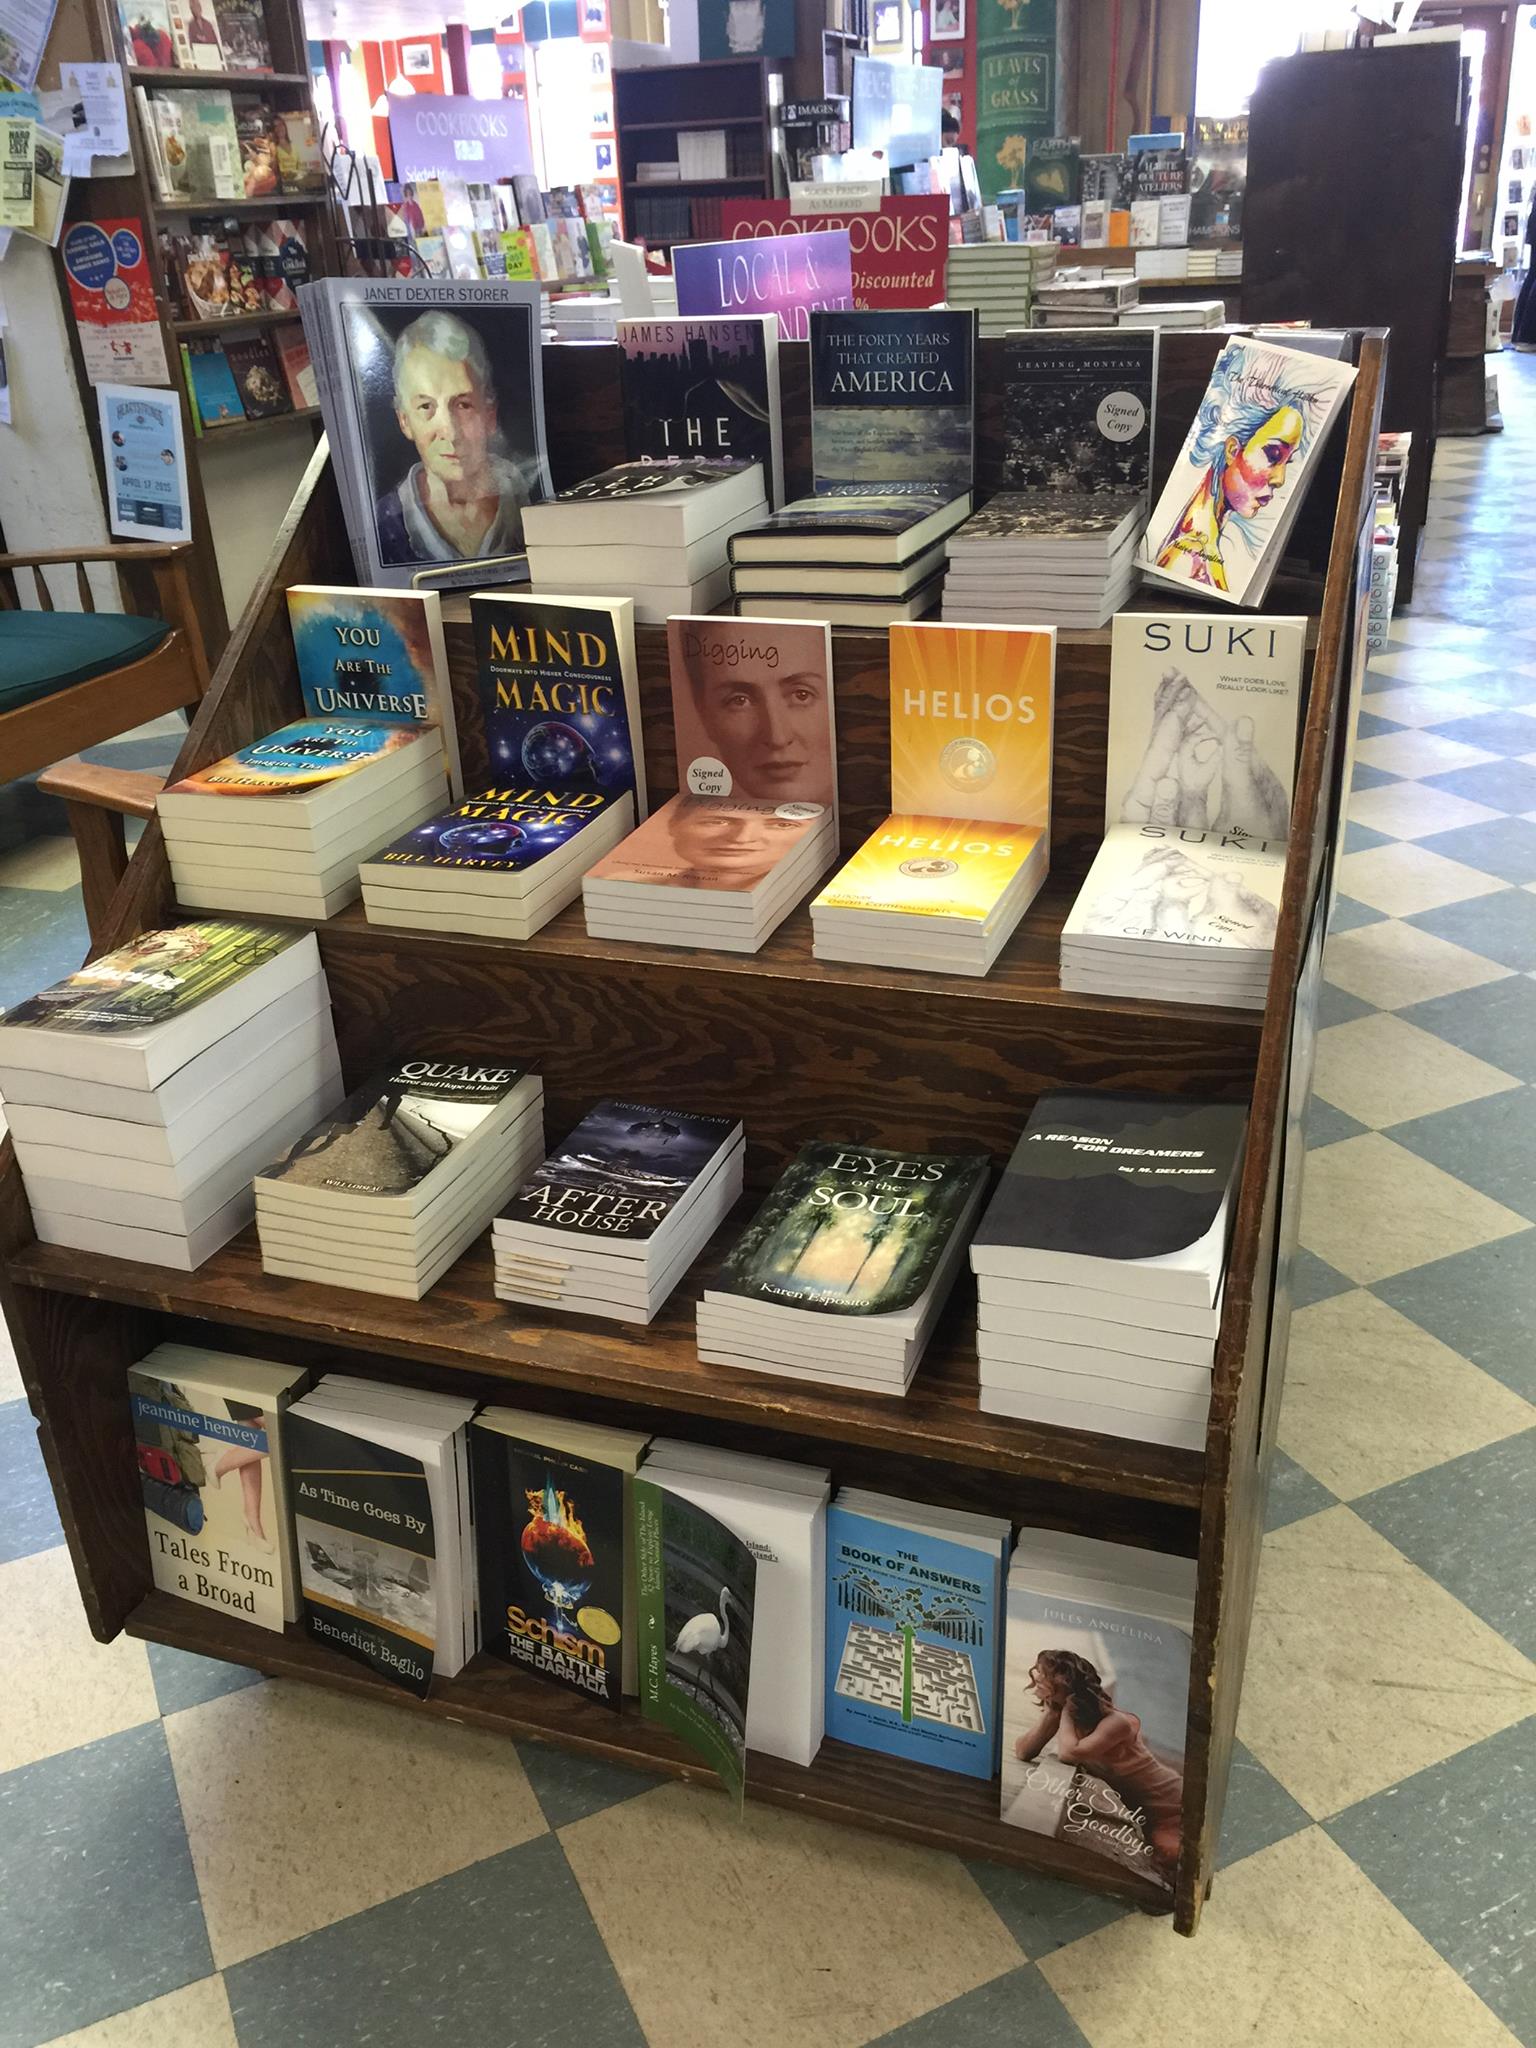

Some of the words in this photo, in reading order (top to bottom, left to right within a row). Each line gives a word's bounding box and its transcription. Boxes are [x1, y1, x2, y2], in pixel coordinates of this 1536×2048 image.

[988, 58, 1041, 78] LEAVES
[991, 89, 1038, 108] GRASS
[798, 105, 833, 115] IMAGES
[416, 111, 508, 138] COOKBOOKS
[1033, 139, 1072, 151] EARTH
[1138, 170, 1184, 182] COUTURE
[717, 252, 796, 307] LOCAL
[805, 246, 821, 291] &
[851, 270, 935, 289] Discounted
[364, 287, 402, 300] JANET
[405, 287, 455, 300] DEXTER
[458, 287, 509, 300] STORER
[623, 326, 674, 343] JAMES
[827, 335, 855, 346] THE
[859, 334, 901, 346] FORTY
[906, 333, 950, 346] YEARS
[837, 352, 873, 365] THAT
[877, 352, 939, 364] CREATED
[1018, 361, 1074, 369] LEAVING
[1083, 360, 1142, 368] MONTANA
[831, 371, 954, 393] AMERICA
[1104, 403, 1140, 418] Signed
[659, 417, 731, 447] THE
[1107, 419, 1133, 433] Copy
[122, 478, 141, 488] APRIL
[335, 627, 380, 646] YOU
[489, 624, 607, 668] MIND
[1144, 622, 1277, 658] SUKI
[685, 634, 780, 668] Digging
[336, 659, 362, 673] ARE
[366, 660, 392, 675] THE
[314, 687, 429, 719] UNIVERSE
[496, 677, 615, 717] MAGIC
[904, 688, 1036, 725] HELIOS
[325, 727, 371, 737] YOU
[252, 745, 373, 762] UNIVERSE
[692, 768, 724, 780] Signed
[474, 787, 605, 808] MIND
[698, 782, 722, 793] Copy
[450, 804, 587, 827] MAGIC
[879, 835, 1014, 857] HELIOS
[1140, 827, 1267, 852] SUKI
[383, 852, 425, 863] BILL
[1164, 931, 1222, 944] WINN
[401, 1061, 518, 1084] QUAKE
[389, 1076, 421, 1087] Horror
[421, 1079, 438, 1089] and
[439, 1082, 464, 1093] Hope
[465, 1083, 475, 1091] in
[476, 1084, 499, 1092] Haiti
[615, 1102, 658, 1114] MICHAEL
[701, 1116, 731, 1125] CASH
[1045, 1134, 1114, 1146] REASON
[1073, 1143, 1108, 1153] FOR
[1109, 1146, 1205, 1158] DREAMERS
[828, 1152, 946, 1182] EYES
[1118, 1165, 1134, 1174] by
[1138, 1166, 1152, 1174] M.
[1155, 1167, 1216, 1175] DELFOSSE
[326, 1179, 348, 1188] WILL
[597, 1185, 618, 1195] THE
[851, 1180, 872, 1188] of
[876, 1181, 902, 1192] the
[520, 1184, 668, 1221] AFTER
[807, 1187, 925, 1218] SOUL
[531, 1205, 635, 1233] HOUSE
[760, 1282, 804, 1299] Karen
[807, 1293, 870, 1307] Esposito
[137, 1397, 200, 1428] jeannine
[203, 1416, 259, 1449] henvey
[299, 1481, 318, 1499] As
[320, 1488, 360, 1512] Time
[363, 1501, 401, 1526] Goes
[403, 1513, 426, 1534] By
[154, 1530, 211, 1568] Tales
[217, 1549, 274, 1588] From
[896, 1550, 919, 1563] THE
[841, 1545, 882, 1567] BOOK
[885, 1559, 905, 1572] OF
[908, 1567, 982, 1595] ANSWERS
[178, 1573, 189, 1591] a
[195, 1574, 256, 1613] Broad
[1043, 1607, 1083, 1626] JULES
[506, 1605, 605, 1668] Schism
[313, 1616, 377, 1656] Benedict
[380, 1646, 425, 1682] Baglio
[508, 1633, 535, 1652] THE
[541, 1644, 606, 1685] BATTLE
[648, 1644, 660, 1675] Hayes
[510, 1646, 535, 1665] FOR
[535, 1654, 609, 1699] DARRACIA
[648, 1678, 660, 1702] M.C.
[1074, 1774, 1097, 1791] The
[1026, 1767, 1082, 1802] Other
[1089, 1788, 1147, 1826] Side
[1063, 1803, 1154, 1857] Goodbye
